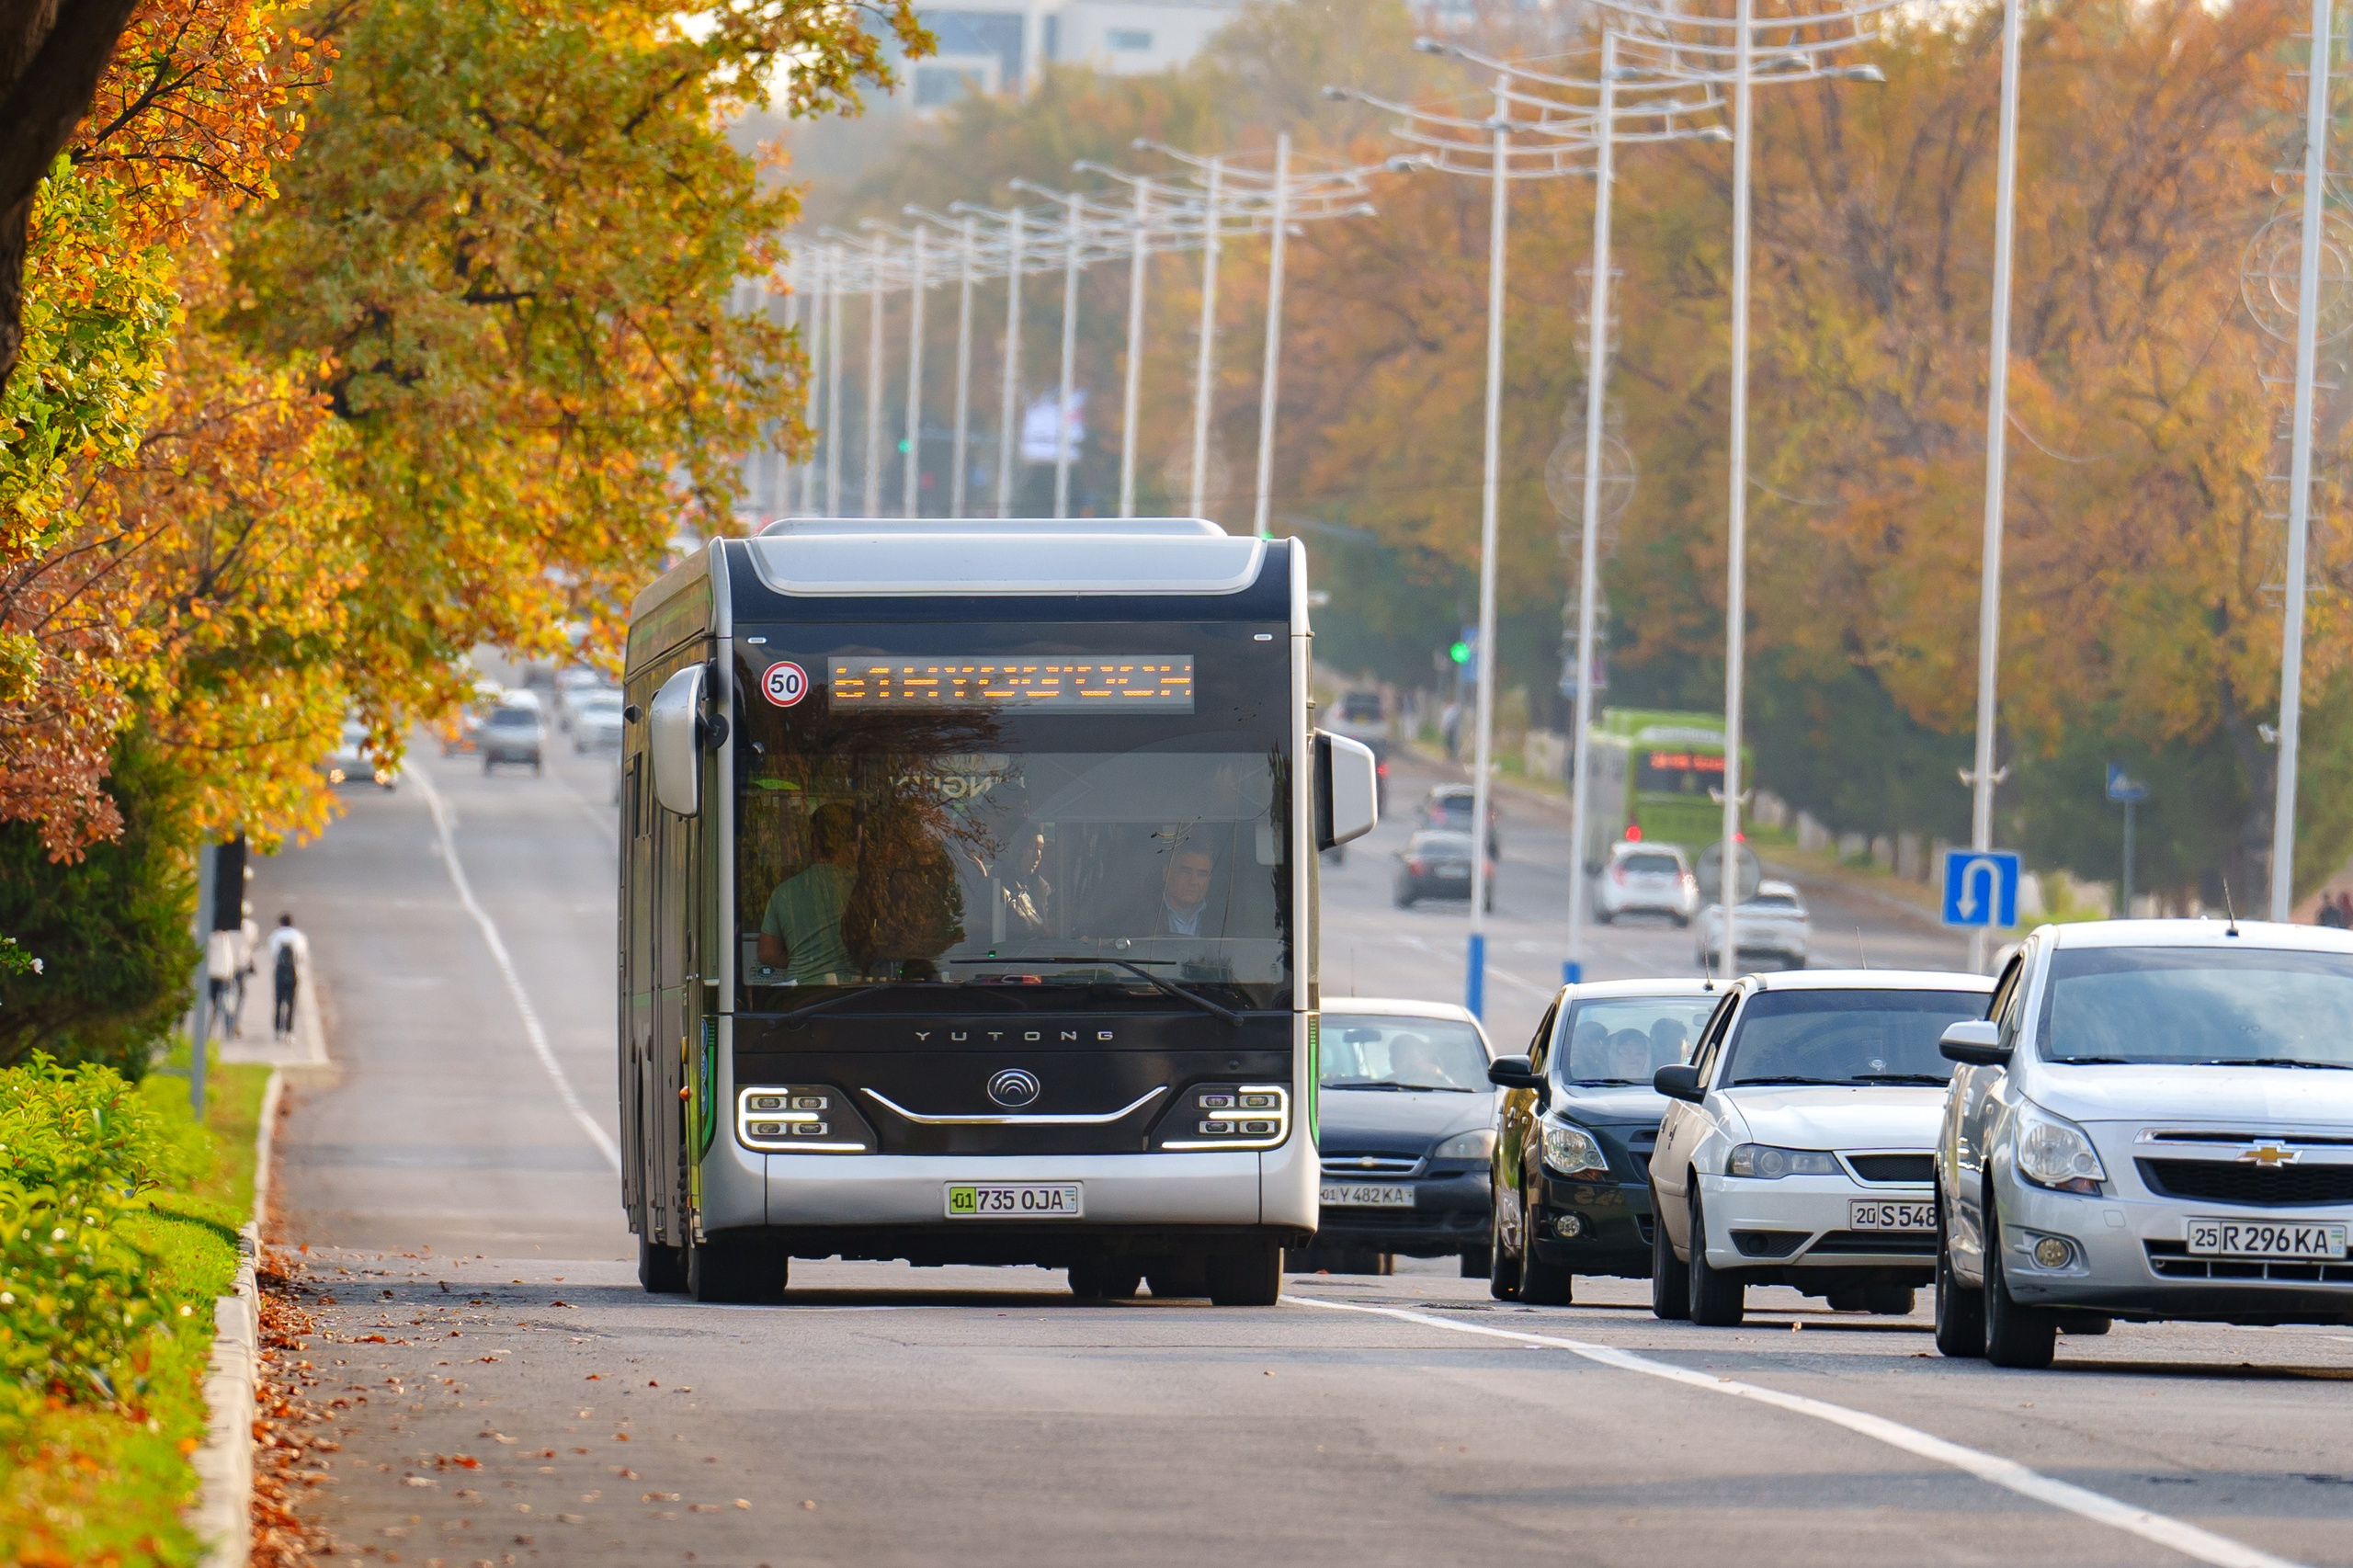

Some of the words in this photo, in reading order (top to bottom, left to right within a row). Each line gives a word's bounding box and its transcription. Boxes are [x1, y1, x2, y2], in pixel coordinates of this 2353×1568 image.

[770, 674, 799, 694] 50
[915, 1030, 1114, 1041] YUTONG
[955, 1192, 974, 1209] 01
[978, 1190, 1015, 1210] 735
[2195, 1228, 2218, 1247] 25
